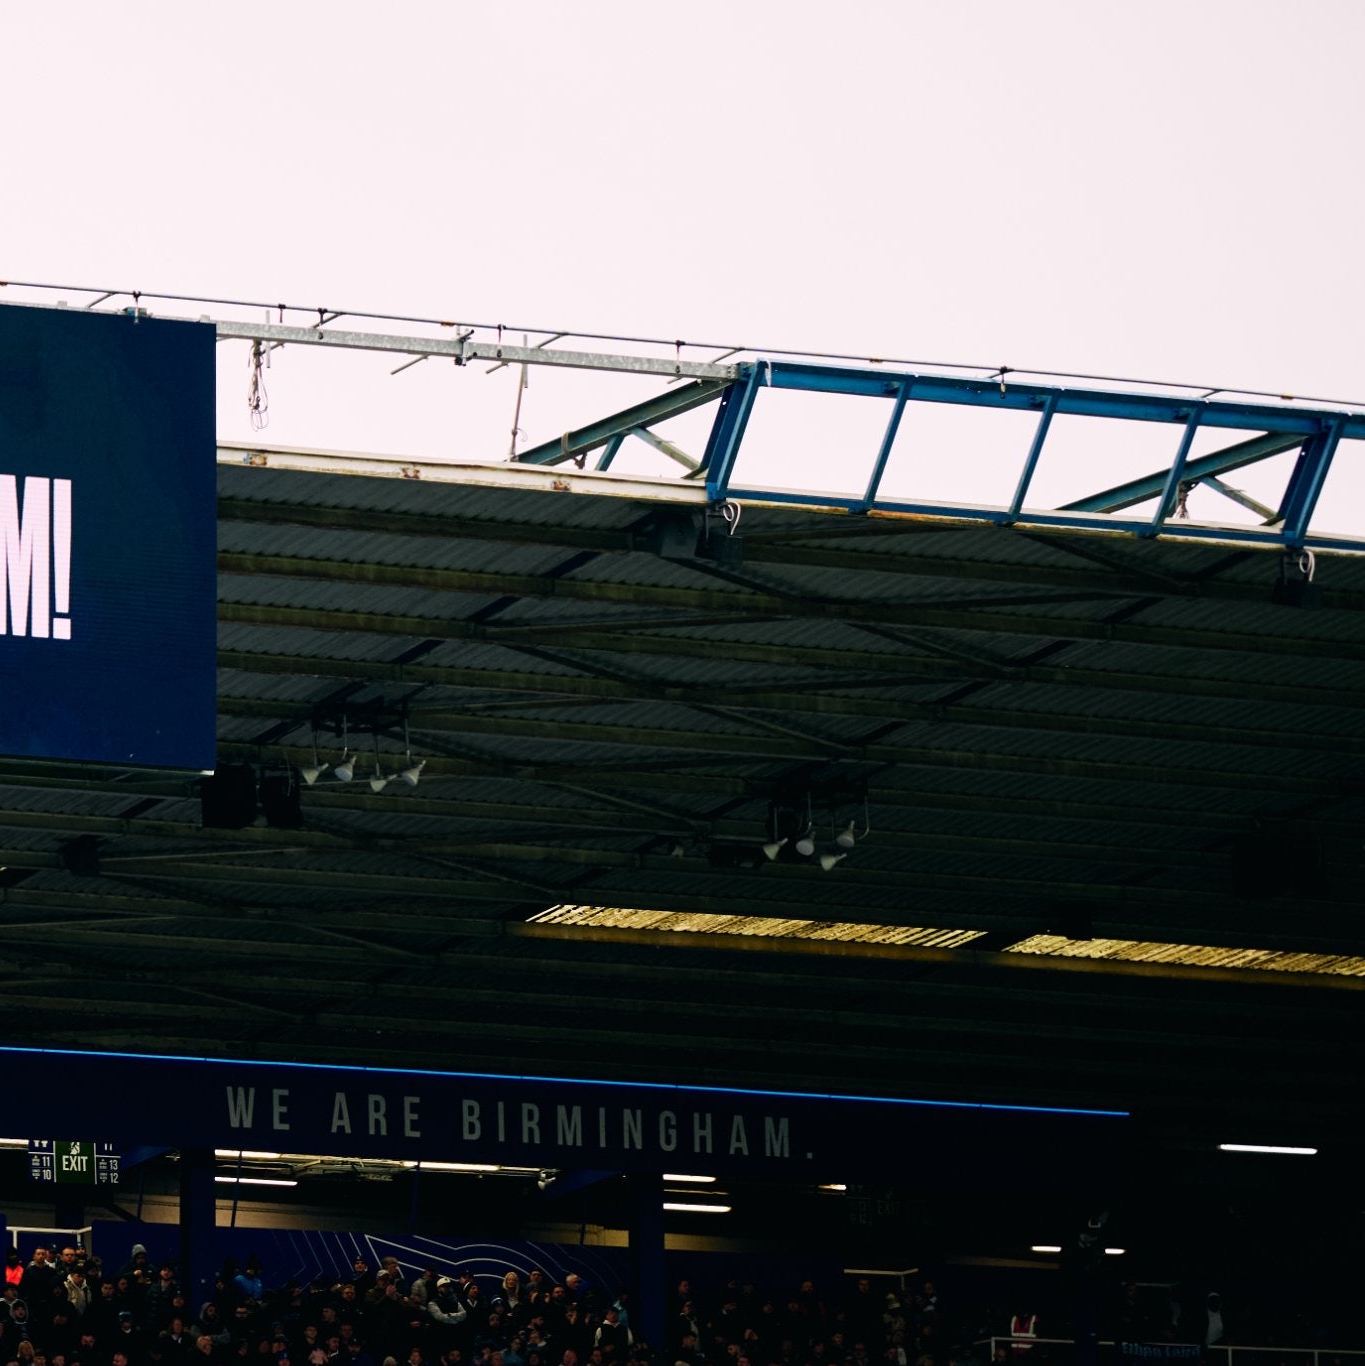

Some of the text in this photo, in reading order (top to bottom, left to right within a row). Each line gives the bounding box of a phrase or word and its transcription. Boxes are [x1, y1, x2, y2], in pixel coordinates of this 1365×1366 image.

[226, 1085, 291, 1131] WE
[331, 1093, 421, 1139] ARE
[42, 1156, 51, 1167] 11
[61, 1155, 88, 1172] EXIT
[109, 1159, 119, 1171] 13
[42, 1169, 52, 1180] 10
[109, 1172, 119, 1184] 12
